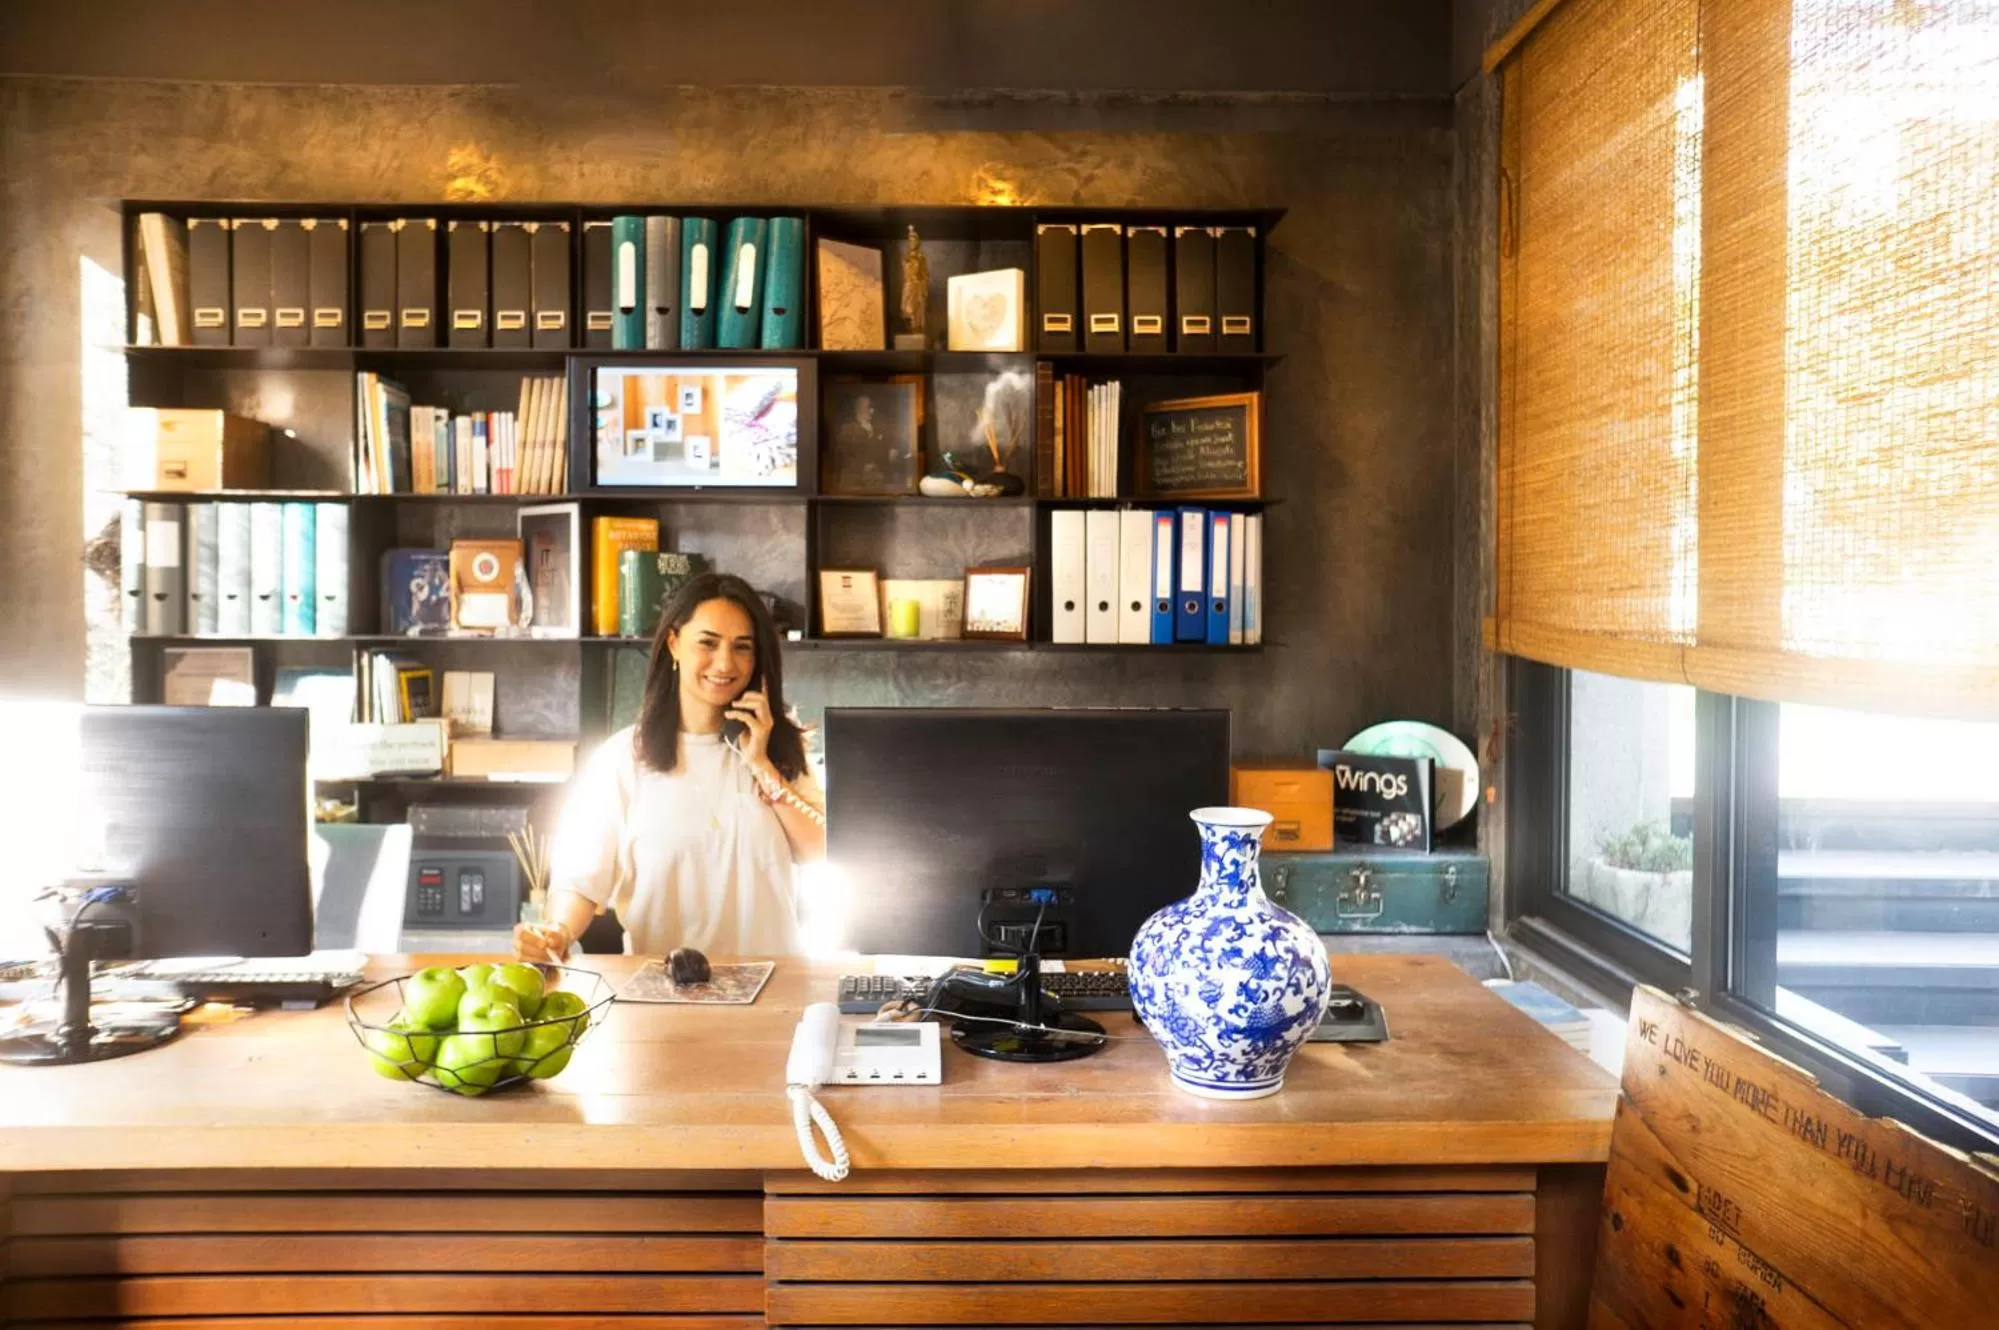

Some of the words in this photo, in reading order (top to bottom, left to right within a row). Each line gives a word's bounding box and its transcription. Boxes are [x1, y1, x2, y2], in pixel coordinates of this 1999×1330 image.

[1638, 1017, 1659, 1045] WE
[1663, 1033, 1700, 1073] LOVE
[1703, 1056, 1730, 1093] YOU
[1734, 1075, 1780, 1125] MORE
[1783, 1106, 1828, 1150] THAN
[1836, 1127, 1877, 1179] YOU
